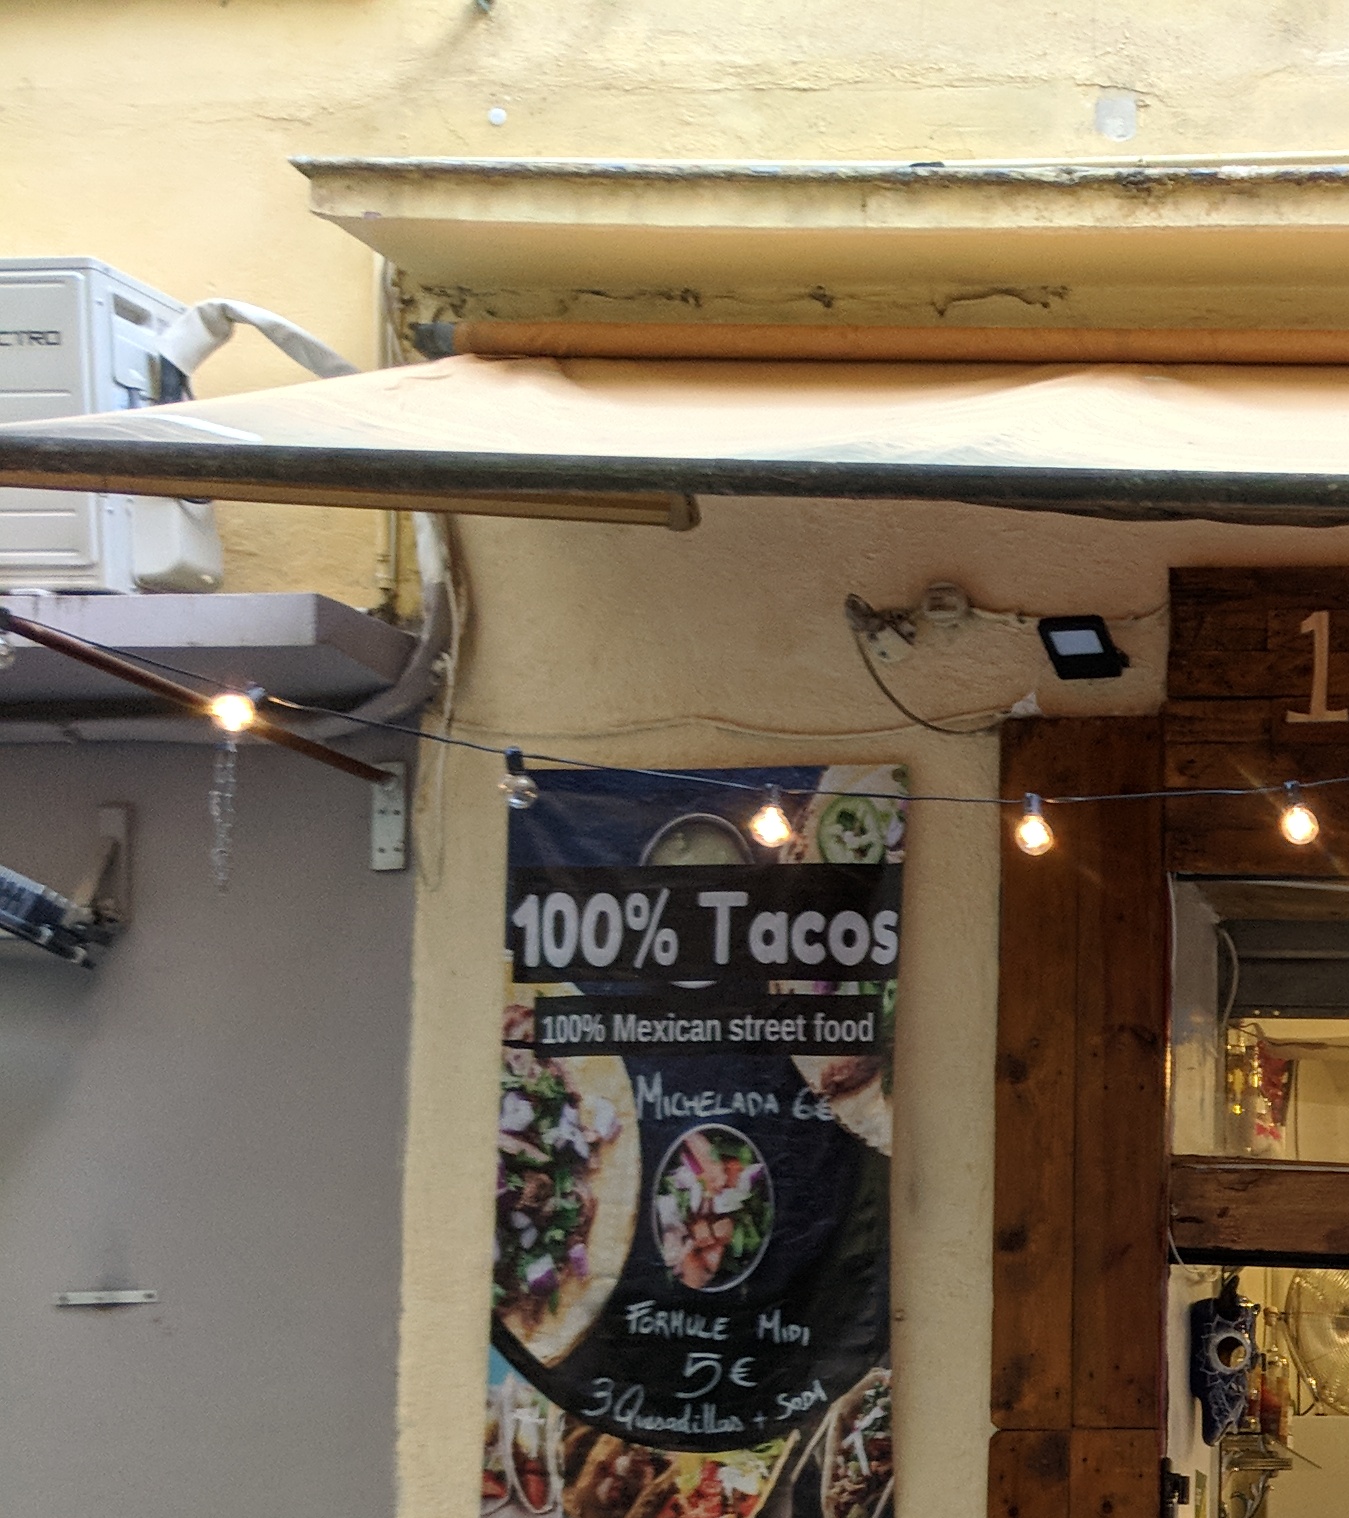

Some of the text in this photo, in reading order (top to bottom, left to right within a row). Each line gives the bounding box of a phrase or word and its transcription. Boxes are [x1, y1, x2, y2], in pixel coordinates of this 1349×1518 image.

[511, 887, 898, 969] 100% Tacos
[541, 1013, 874, 1044] 100% Mexican street food
[580, 1377, 615, 1417] 3
